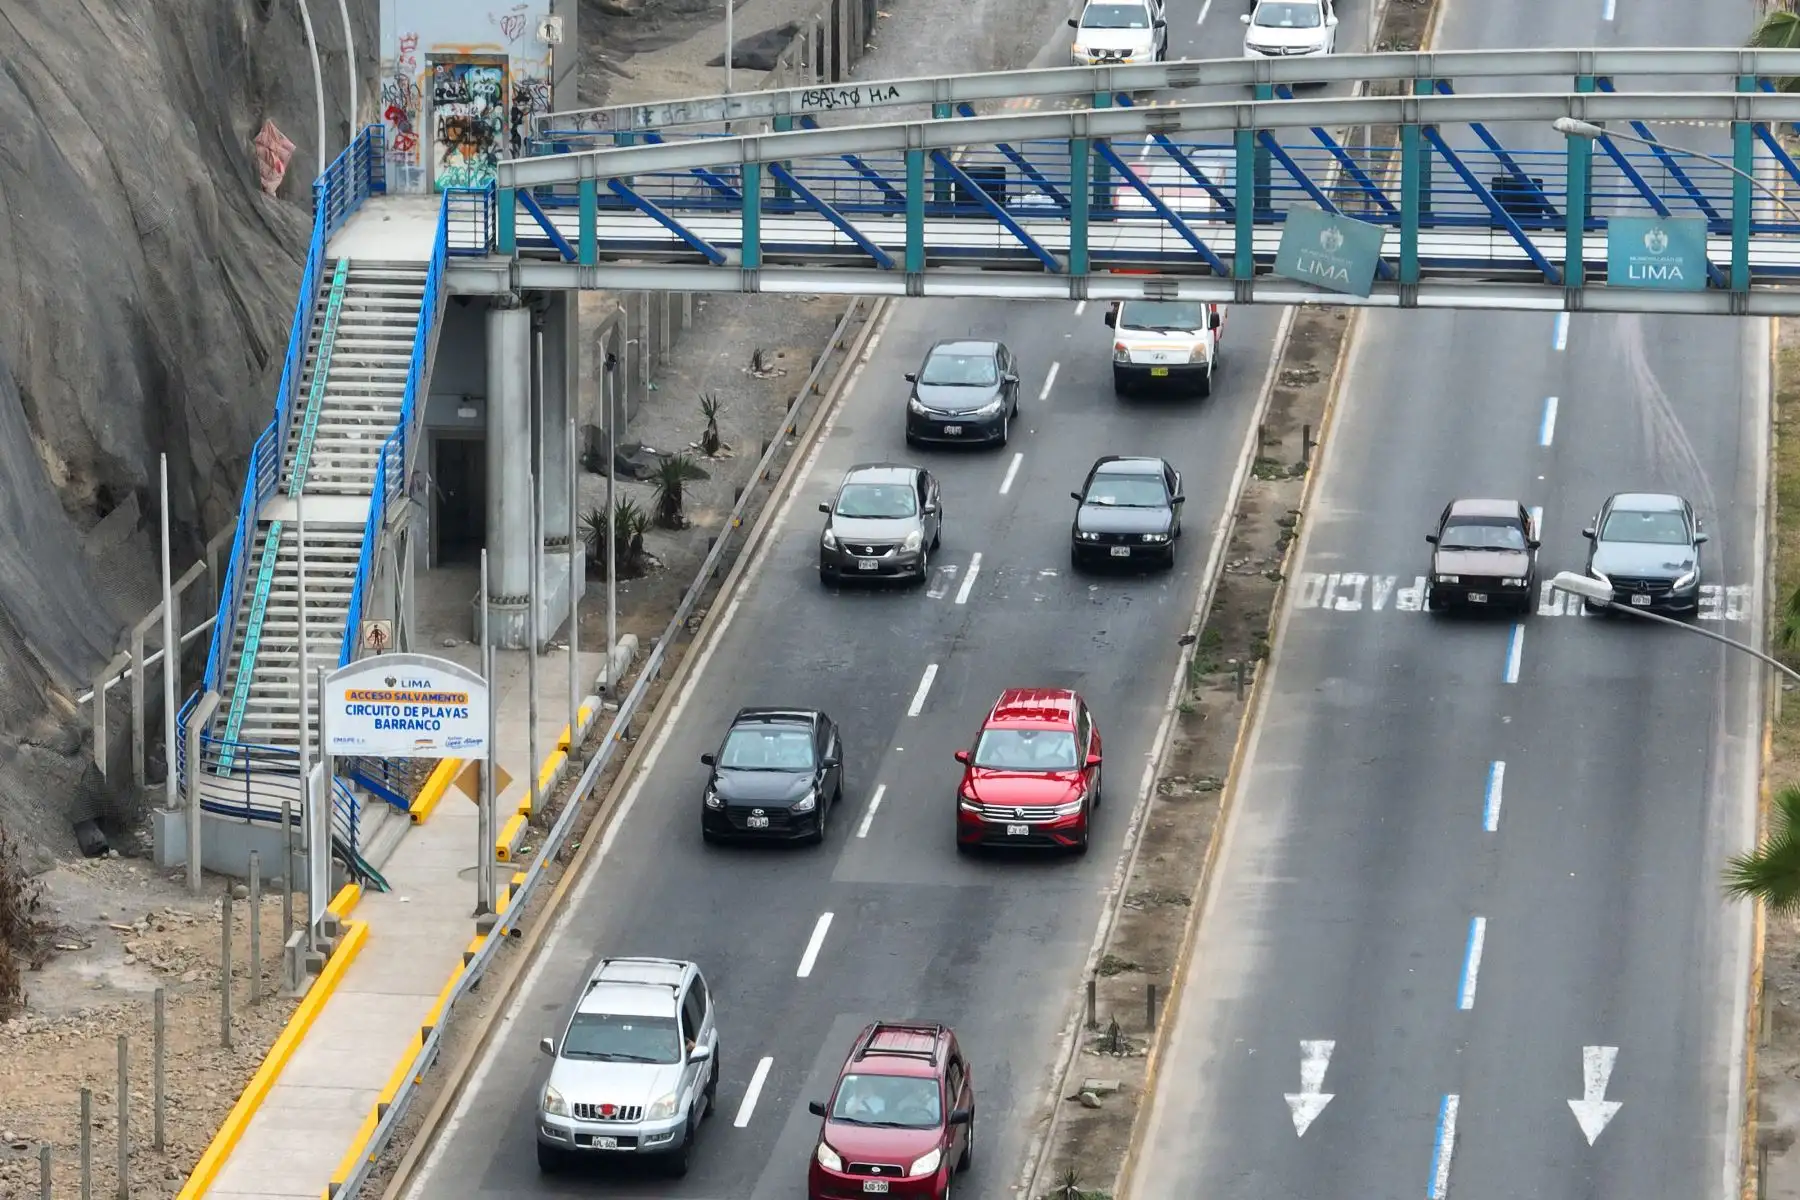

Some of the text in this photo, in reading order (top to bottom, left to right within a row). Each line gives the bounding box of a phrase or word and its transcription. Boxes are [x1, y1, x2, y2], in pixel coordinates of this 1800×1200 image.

[1296, 257, 1349, 283] LIMA
[1628, 264, 1684, 280] LIMA
[401, 679, 432, 689] LIMA
[350, 691, 466, 703] ACCESO SALVAMENTO
[345, 704, 469, 719] CIRCUITO DE PLAYAS
[374, 718, 441, 731] BARRANCO
